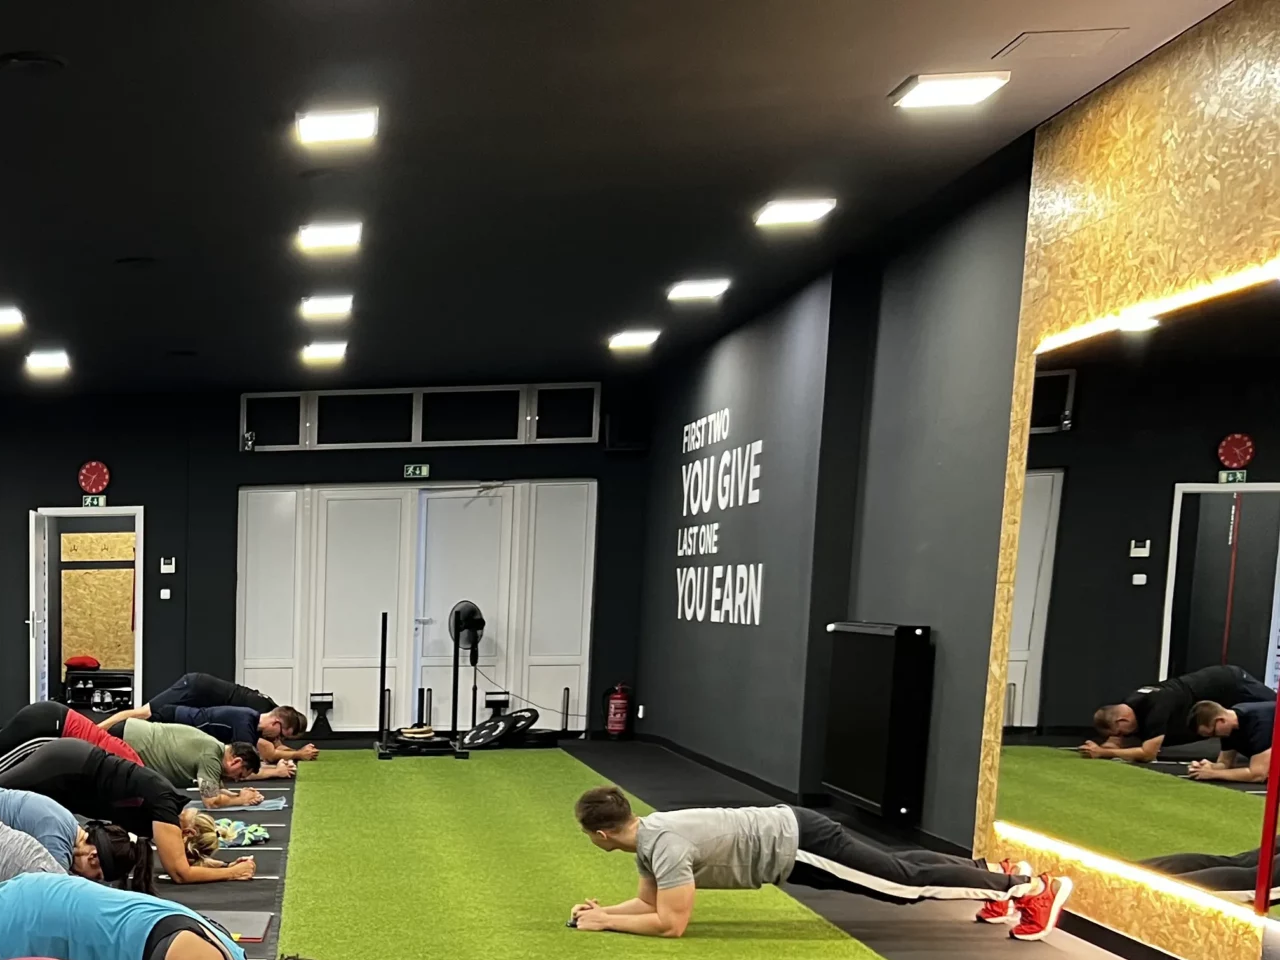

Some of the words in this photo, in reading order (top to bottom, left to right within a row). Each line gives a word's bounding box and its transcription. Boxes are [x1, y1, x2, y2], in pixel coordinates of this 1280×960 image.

[682, 416, 708, 454] FIRST
[707, 407, 730, 445] TWO
[681, 455, 715, 517] YOU
[717, 440, 763, 511] GIVE
[677, 525, 699, 557] LAST
[699, 522, 720, 555] ONE
[676, 566, 709, 623] YOU
[710, 562, 763, 626] EARN
